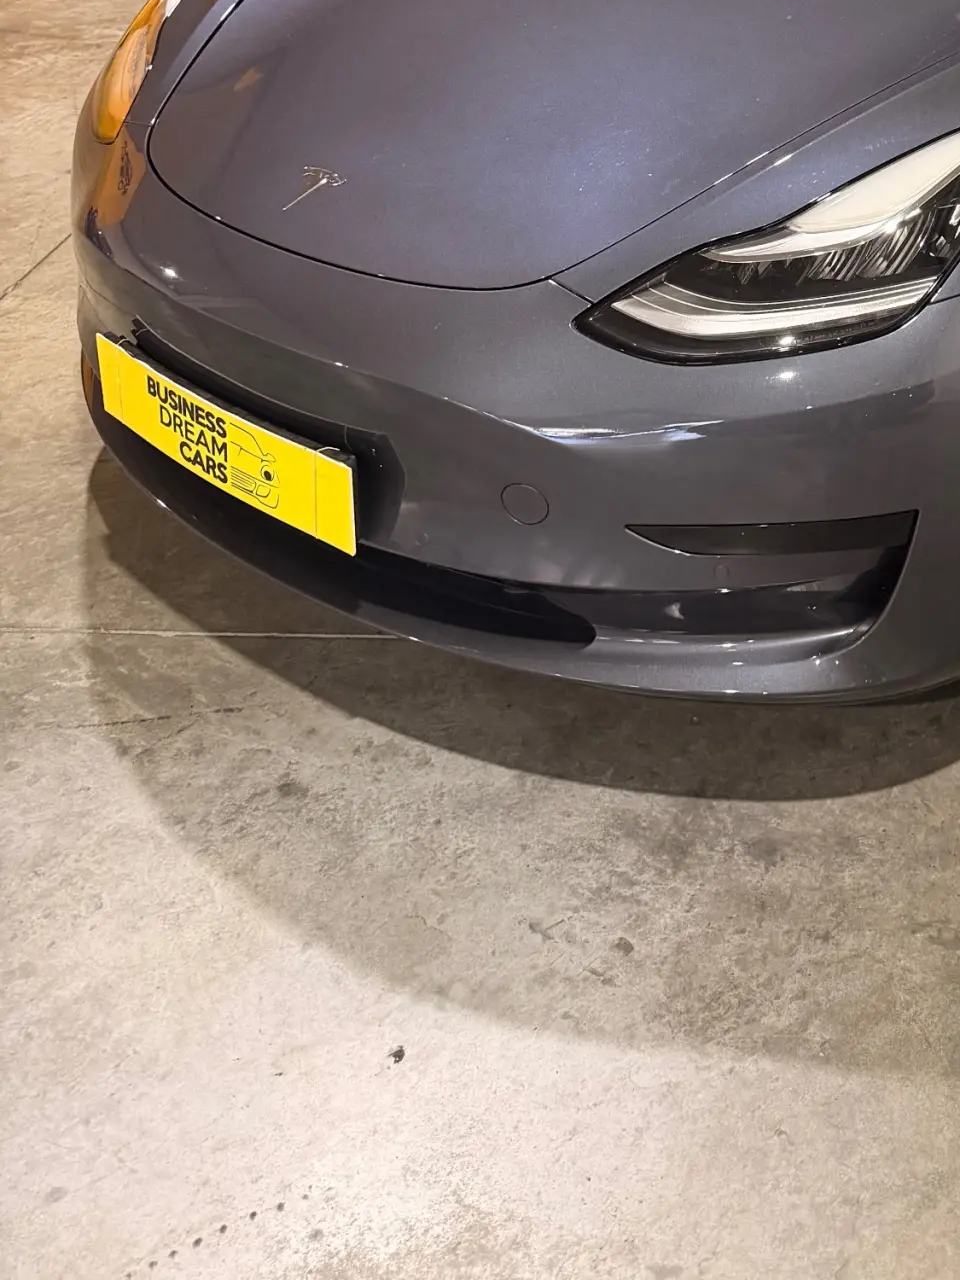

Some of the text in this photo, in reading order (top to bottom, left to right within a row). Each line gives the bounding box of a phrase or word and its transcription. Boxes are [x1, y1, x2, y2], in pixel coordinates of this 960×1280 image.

[147, 375, 227, 439] BUSINESS
[160, 405, 228, 463] DREAM
[179, 441, 228, 484] CARS
